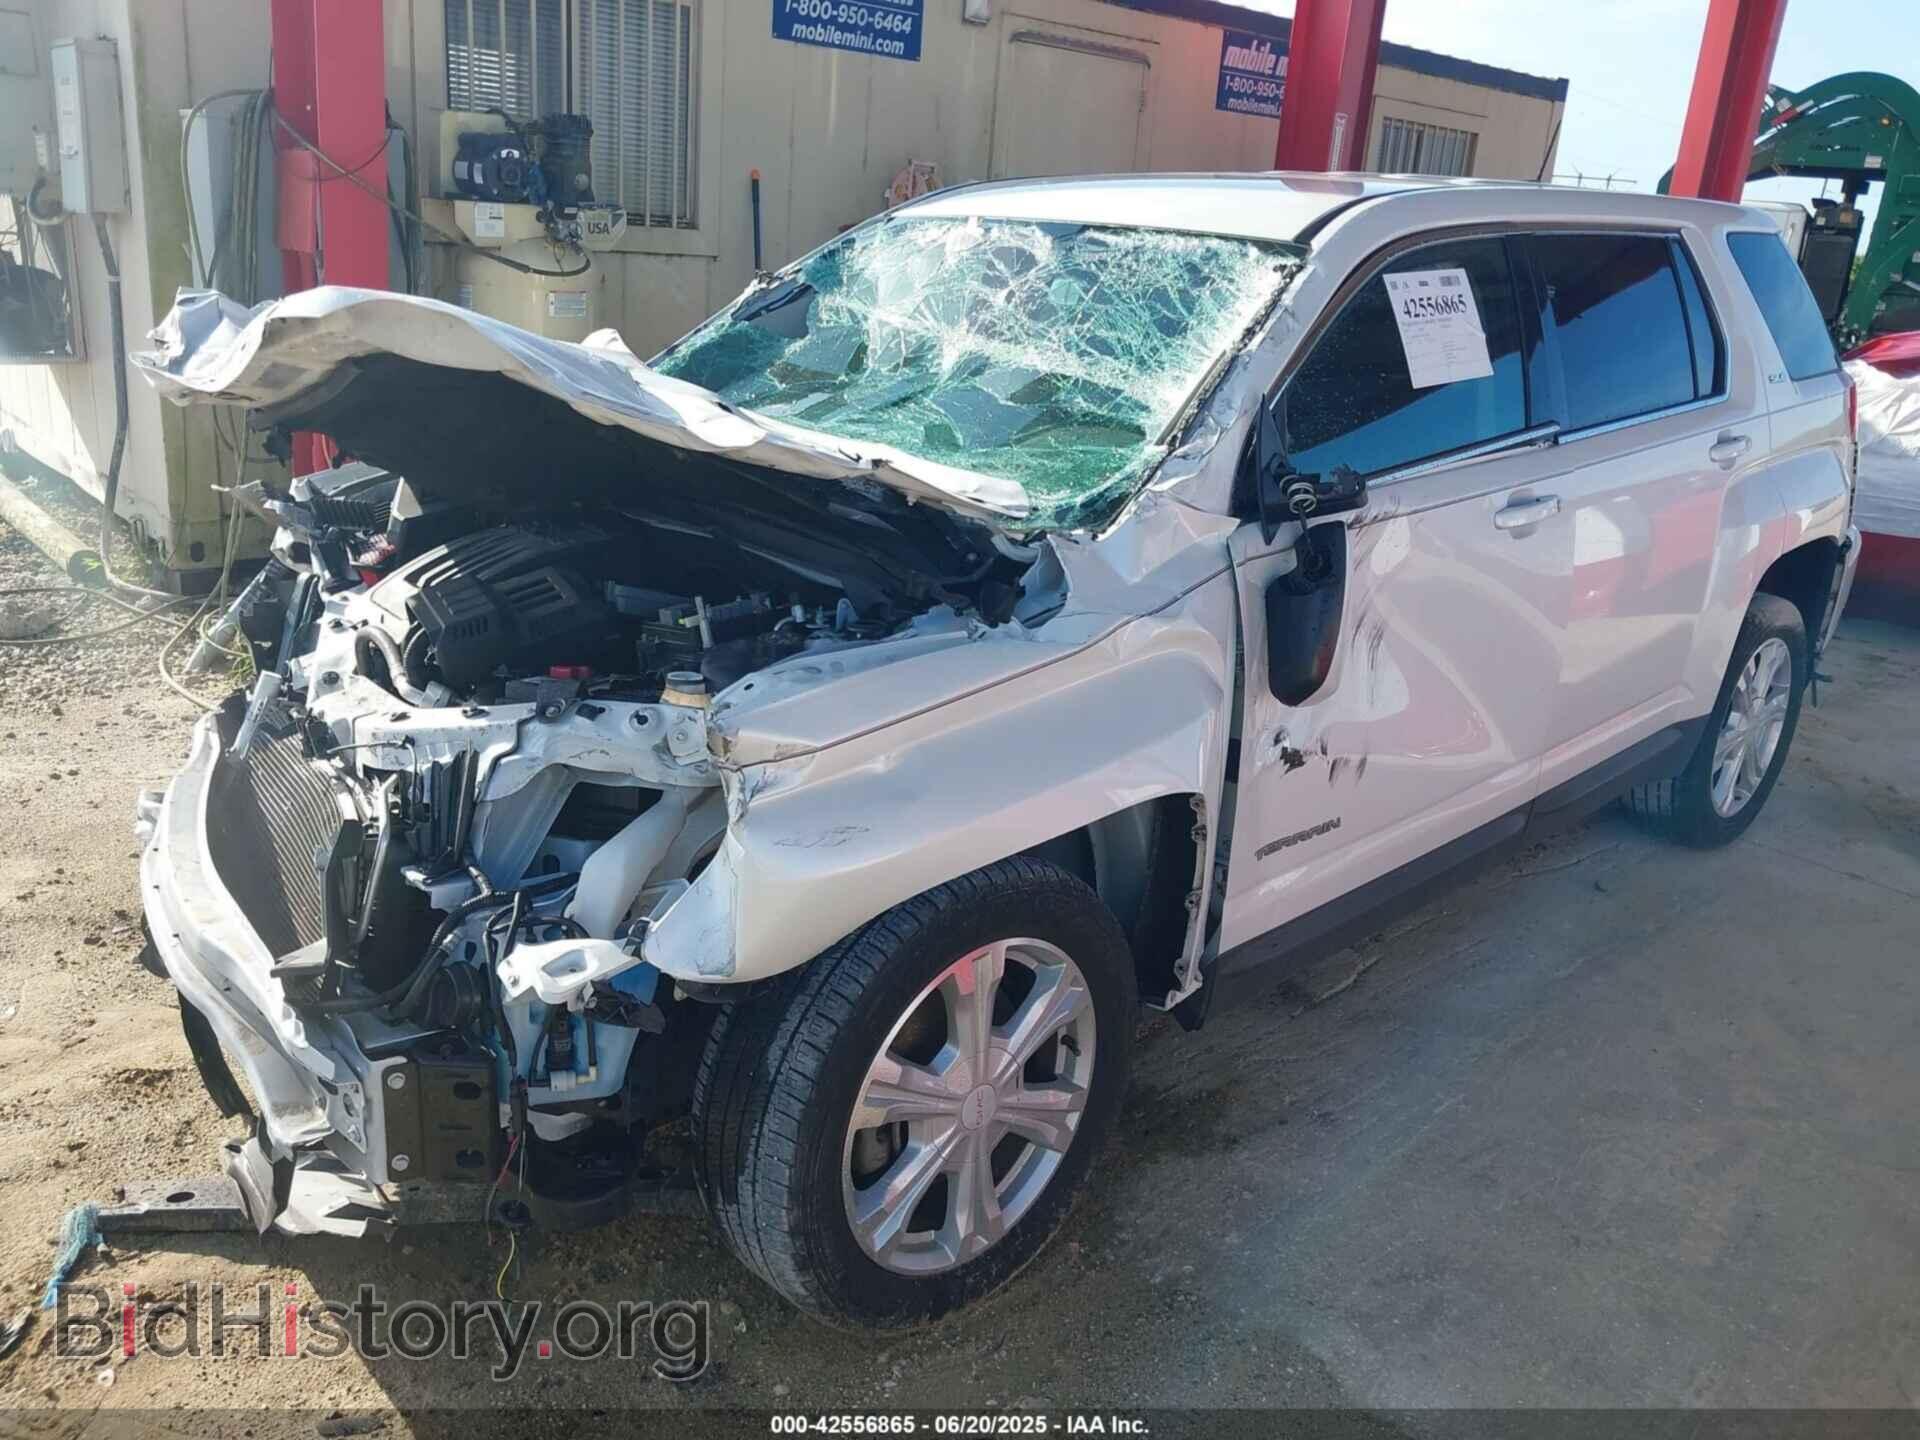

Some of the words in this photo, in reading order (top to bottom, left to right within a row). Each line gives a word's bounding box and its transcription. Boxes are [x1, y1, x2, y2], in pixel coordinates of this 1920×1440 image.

[785, 0, 913, 34] 1-800-950-6464
[791, 23, 905, 55] mobilemini.com
[1223, 40, 1277, 76] mobile
[1224, 75, 1286, 100] 1-800-950-6
[1227, 97, 1282, 115] mobilemini.
[587, 222, 611, 235] USA
[1402, 294, 1468, 319] 42556865
[1254, 816, 1342, 861] TERRAIN
